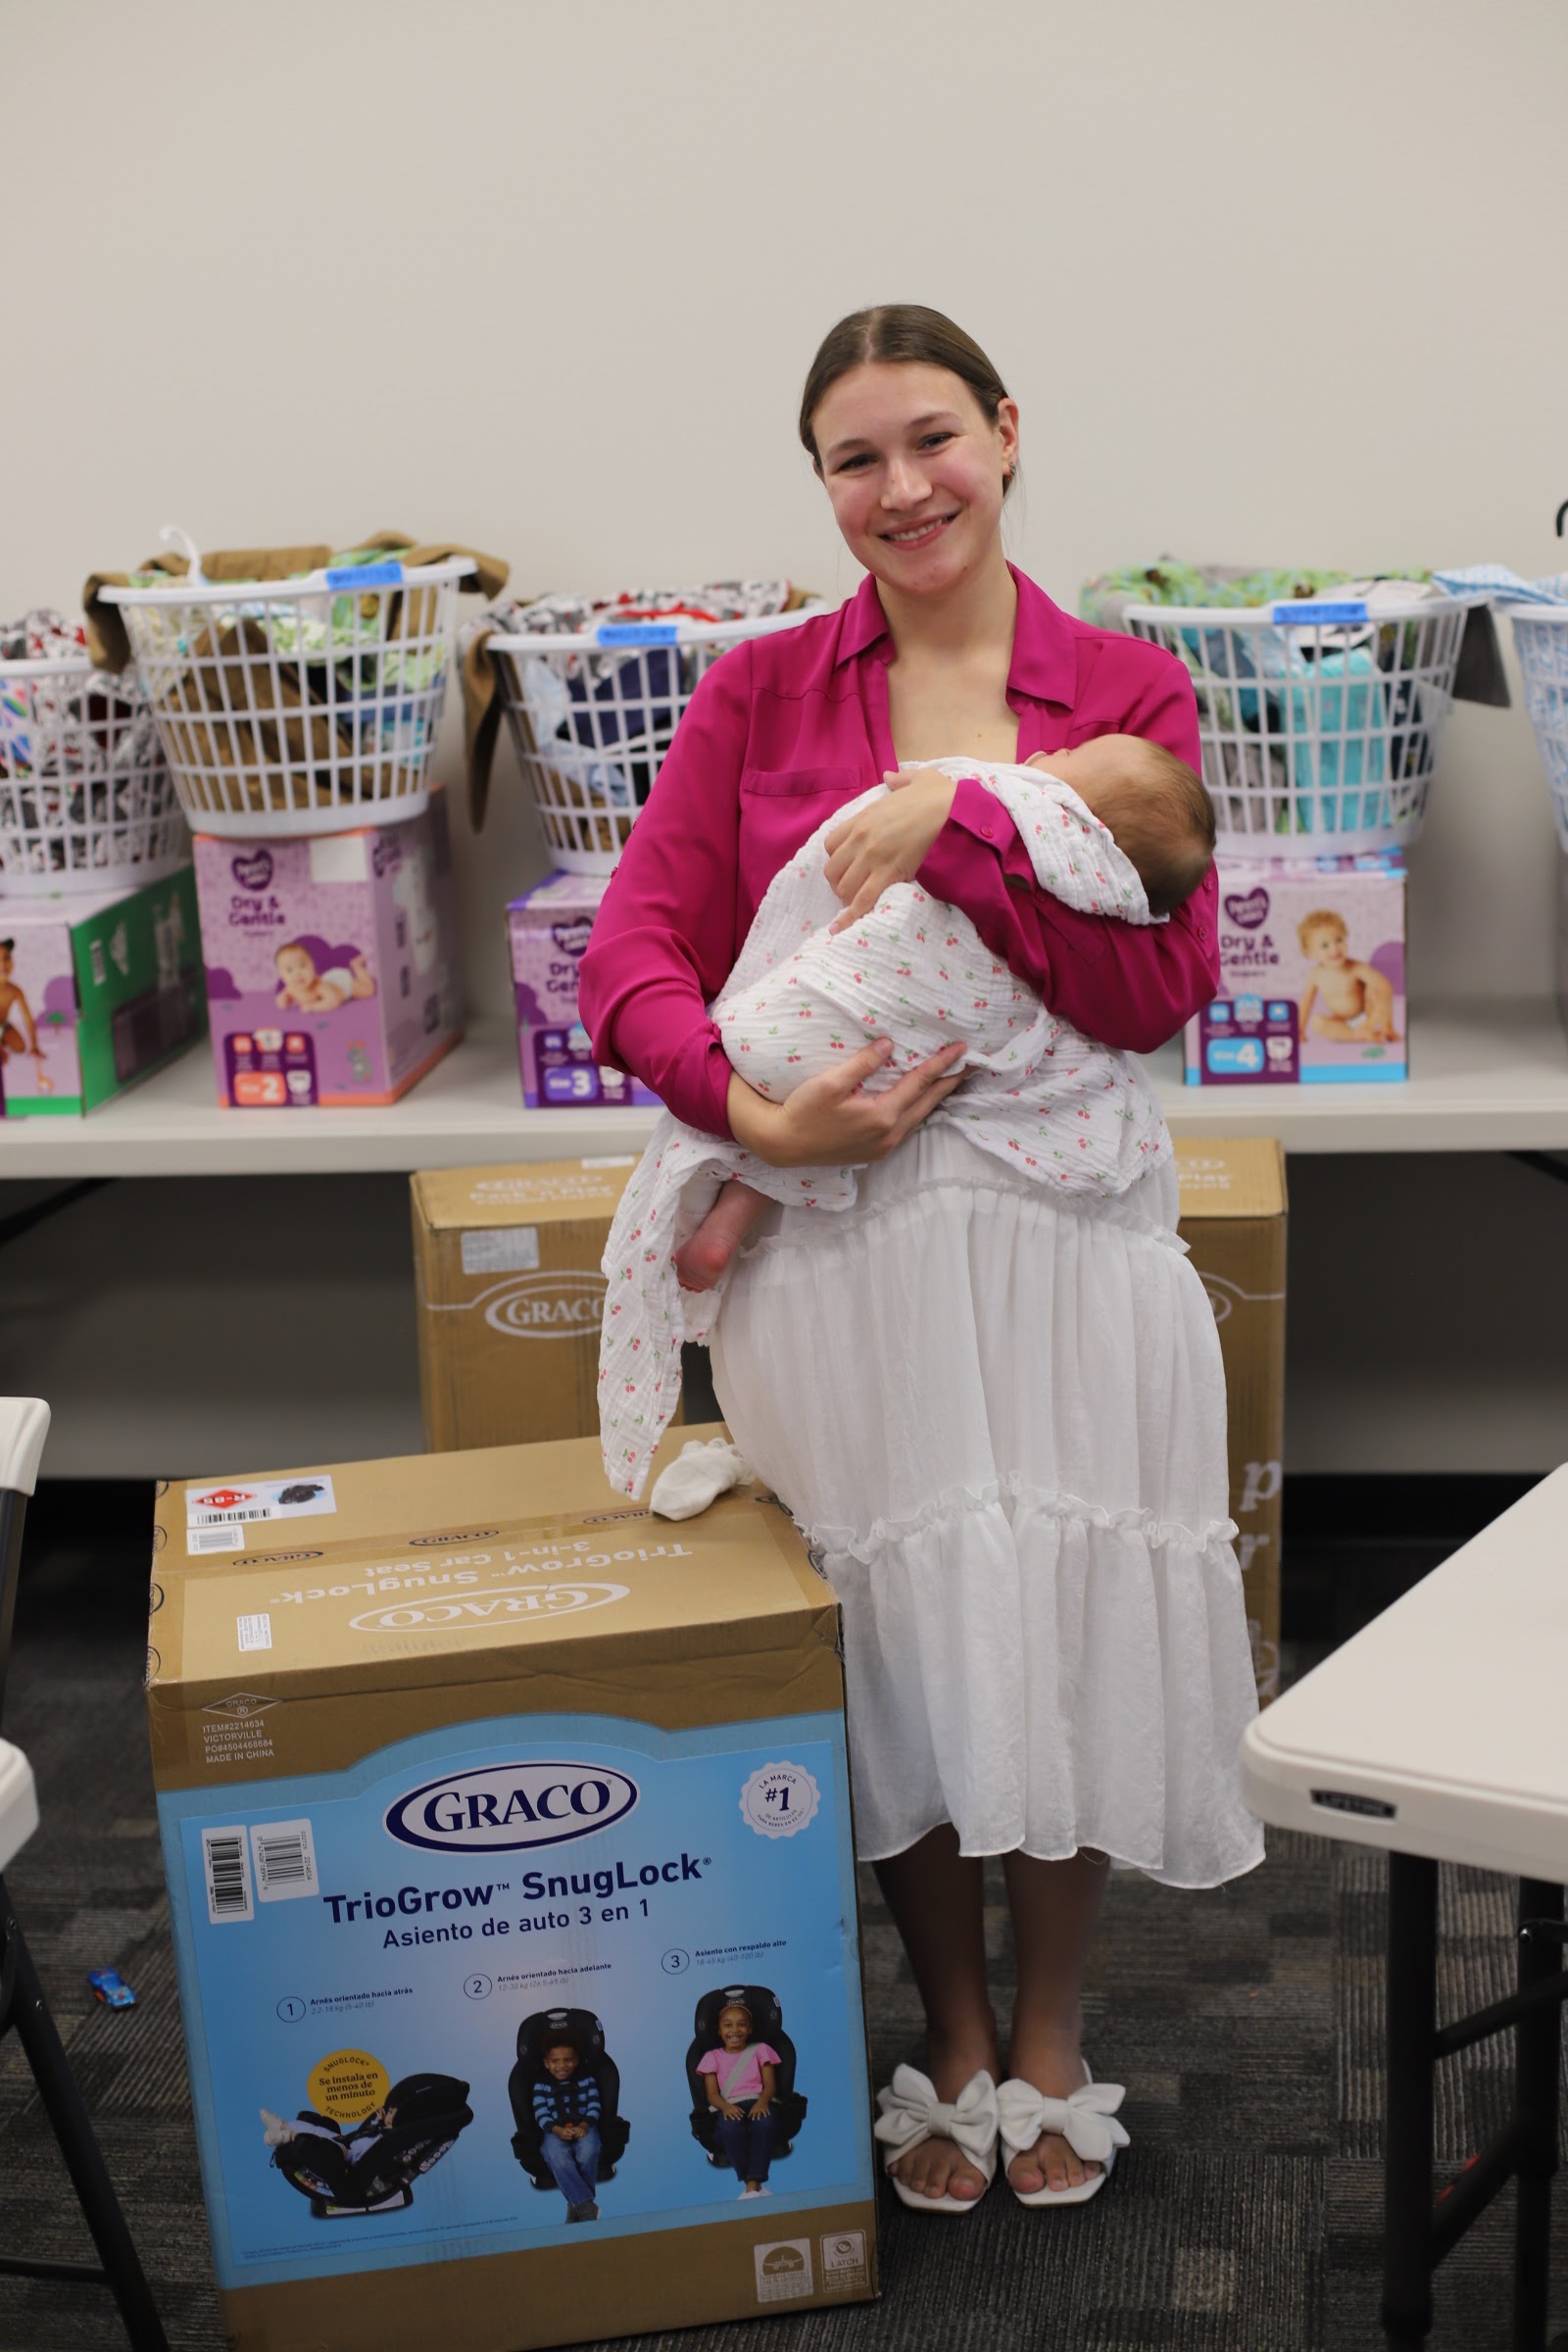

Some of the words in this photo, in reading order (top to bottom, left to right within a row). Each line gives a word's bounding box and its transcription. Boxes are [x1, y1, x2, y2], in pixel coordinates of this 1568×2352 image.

[231, 897, 262, 911] Dry
[229, 911, 285, 925] Gentle
[1221, 935, 1258, 952] Dry
[1261, 935, 1274, 948] &
[1236, 1042, 1258, 1066] 4
[262, 1075, 281, 1101] 2
[571, 1068, 591, 1096] 3
[504, 1542, 591, 1562] 3-in-1
[440, 1553, 491, 1567] Car
[364, 1560, 431, 1578] Seat
[225, 1697, 258, 1708] GRACO
[203, 1719, 265, 1734] ITEM#2214634
[203, 1729, 263, 1743] VICTORVILLE
[206, 1752, 232, 1764] MADE
[234, 1752, 244, 1761] IN
[246, 1748, 274, 1760] CHINA
[758, 1779, 769, 1789] LA
[769, 1774, 797, 1785] MARCA
[764, 1787, 790, 1812] #1
[382, 1923, 473, 1949] Asiento
[481, 1917, 511, 1936] de
[518, 1911, 570, 1933] auto
[578, 1906, 593, 1926] 3
[601, 1904, 629, 1923] en
[639, 1898, 649, 1917] 1
[695, 1948, 723, 1957] Asiento
[738, 1941, 771, 1952] respaldo
[670, 1954, 680, 1969] 3
[497, 1974, 519, 1983] Arnés
[520, 1969, 557, 1980] orientado
[558, 1967, 578, 1976] hacia
[579, 1962, 612, 1973] adelante
[472, 1980, 483, 1993] 2
[310, 1997, 333, 2006] Arnés
[333, 1991, 370, 2002] orientado
[371, 1989, 392, 1998] hacia
[393, 1986, 414, 1995] atrás
[286, 2002, 294, 2017] 1
[318, 2077, 331, 2086] Se
[332, 2073, 365, 2084] instala
[326, 2082, 359, 2093] menos
[360, 2080, 372, 2088] de
[340, 2088, 375, 2100] minuto
[325, 2101, 376, 2119] TECHNOLOGY
[831, 2257, 859, 2268] LATCH
